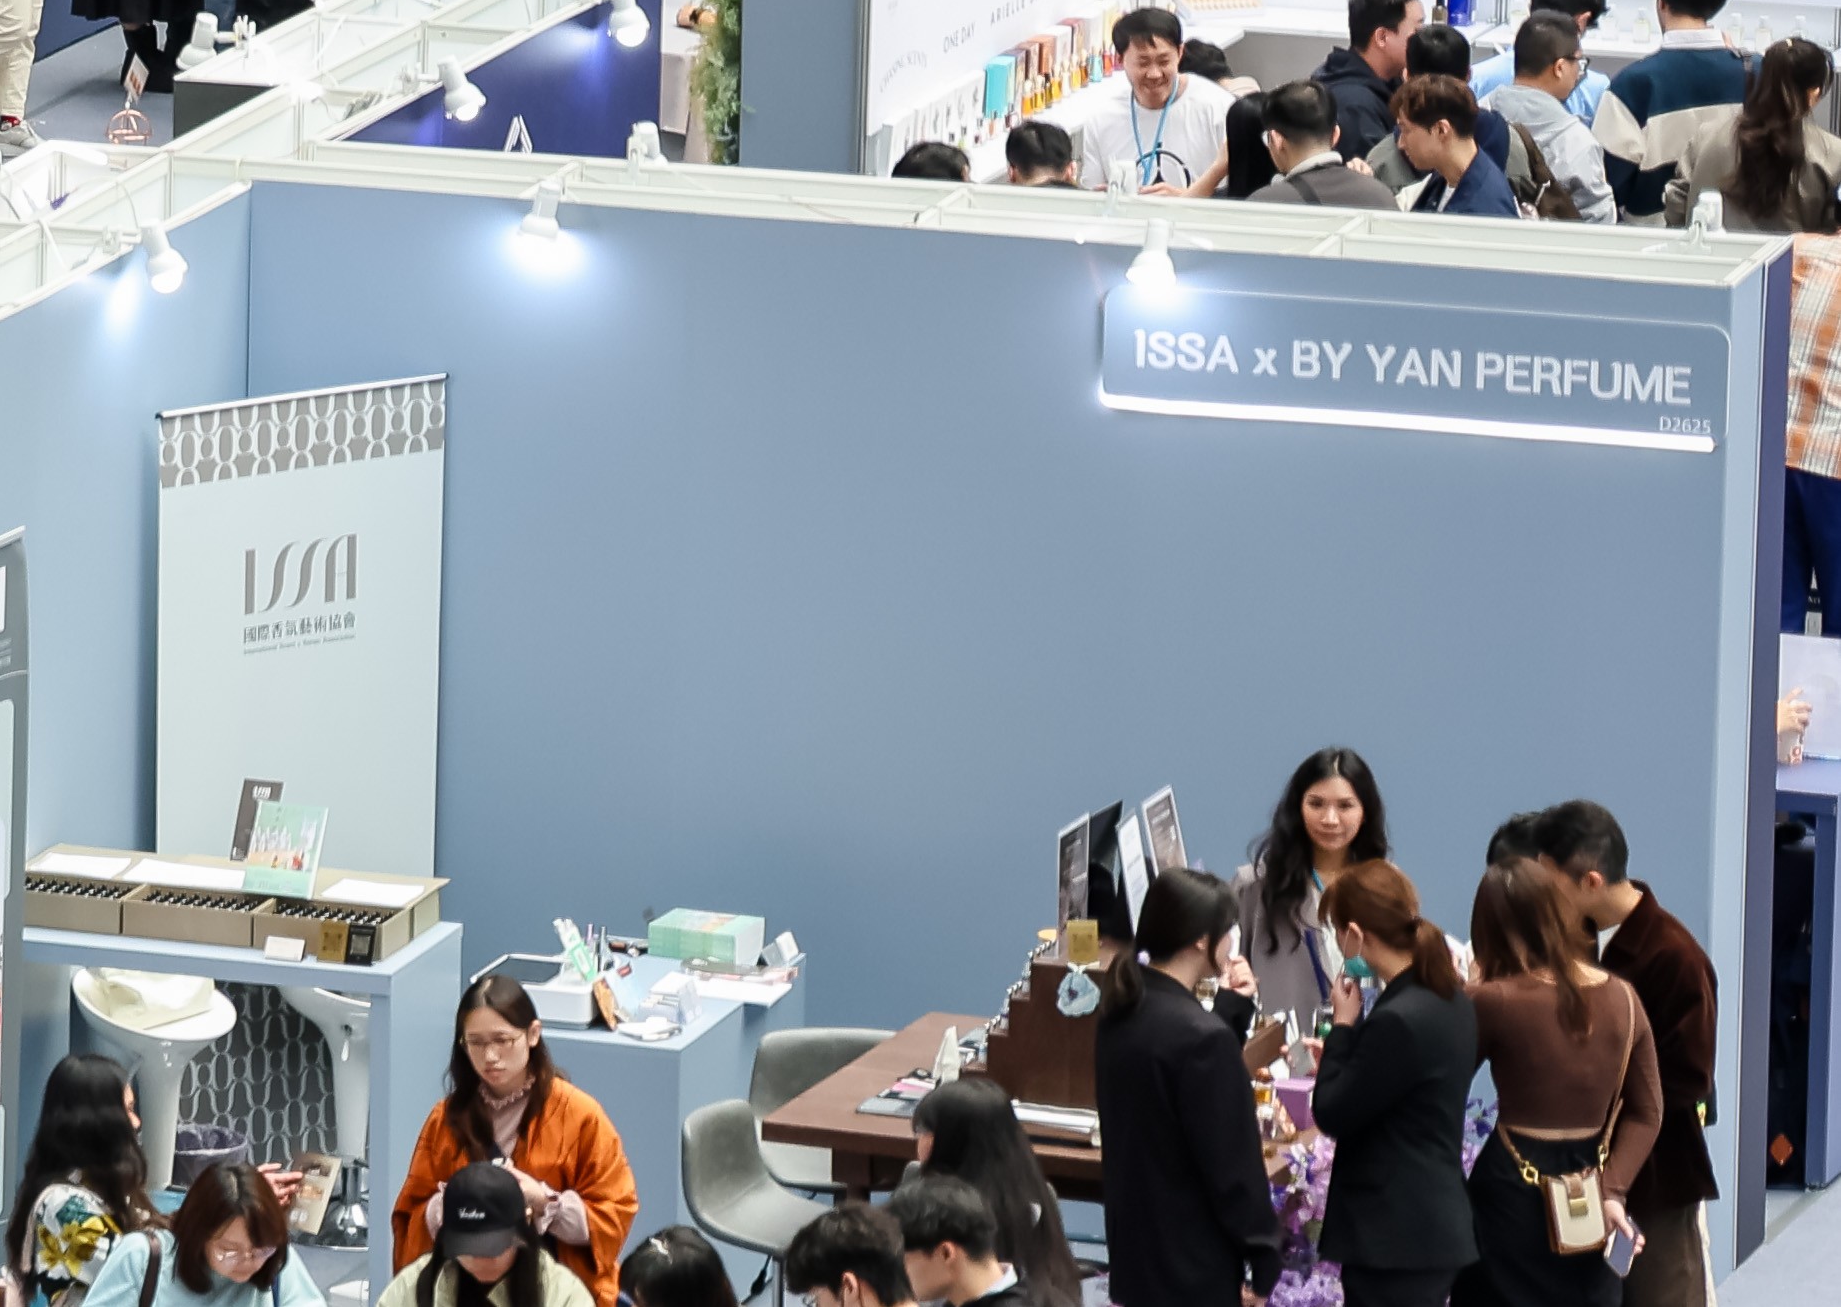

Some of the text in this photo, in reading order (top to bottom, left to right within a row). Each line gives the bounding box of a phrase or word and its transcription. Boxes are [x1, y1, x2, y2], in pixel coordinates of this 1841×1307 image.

[1133, 327, 1693, 407] ISSA x BY YAN PERFUME
[1658, 415, 1711, 436] D2625
[244, 533, 357, 615] ISSA
